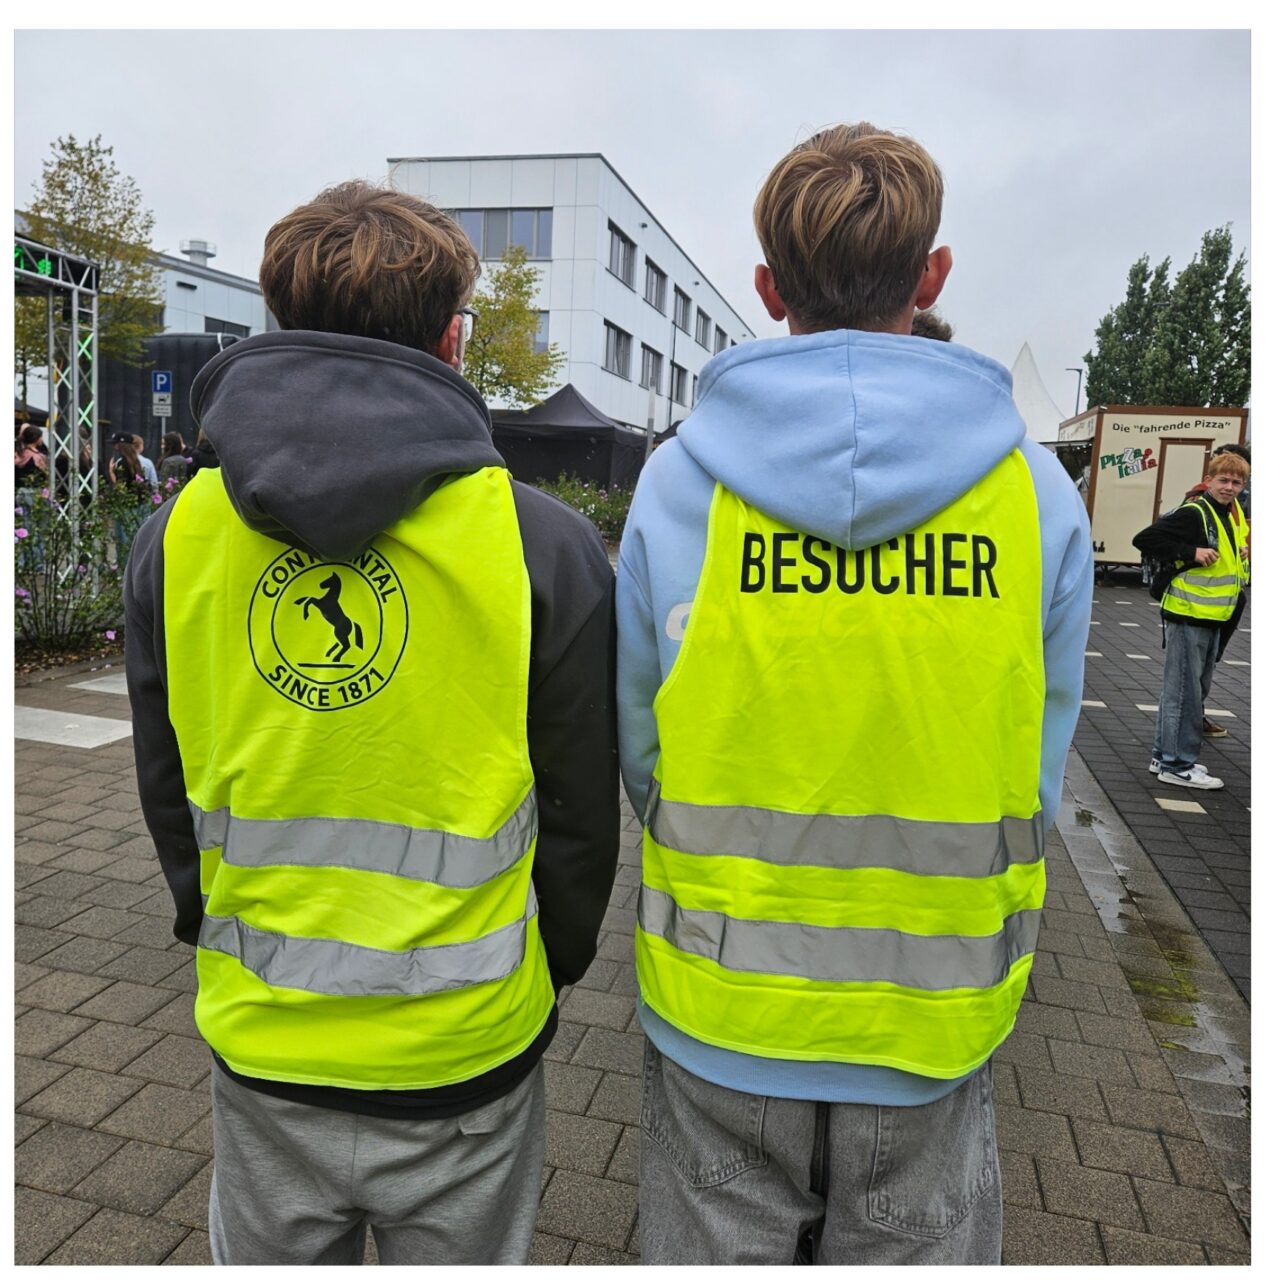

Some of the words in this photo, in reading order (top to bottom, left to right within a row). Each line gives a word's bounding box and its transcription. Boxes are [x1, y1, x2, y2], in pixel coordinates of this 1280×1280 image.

[156, 374, 167, 390] P
[1113, 423, 1131, 433] Die
[262, 552, 398, 603] CONNTAL
[740, 531, 1000, 599] BESUCHER
[268, 665, 331, 706] SINCE
[337, 667, 385, 703] 1871
